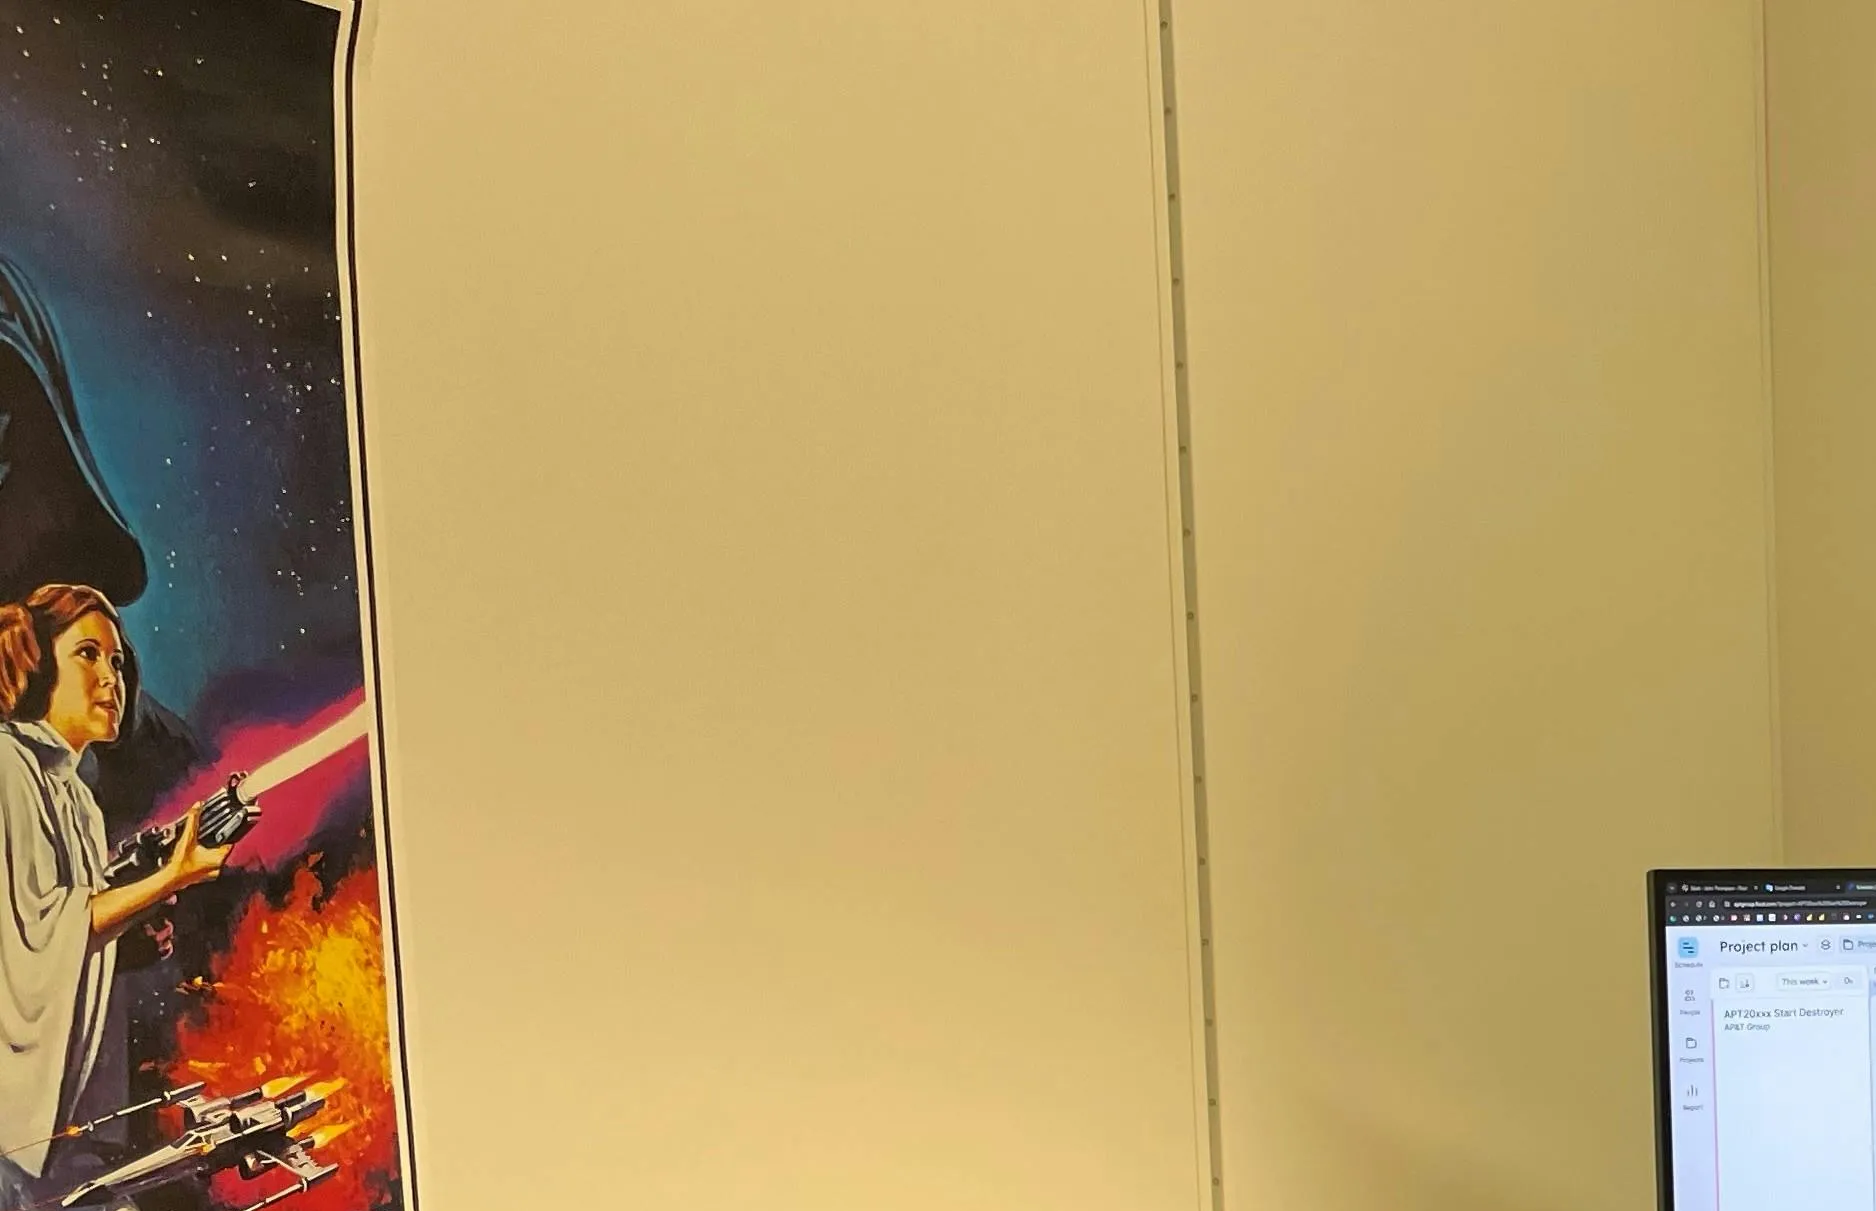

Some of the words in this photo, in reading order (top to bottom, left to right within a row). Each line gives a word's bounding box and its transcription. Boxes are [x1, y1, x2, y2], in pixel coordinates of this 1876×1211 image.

[1720, 940, 1765, 954] Project
[1770, 940, 1798, 954] plan
[1782, 977, 1798, 986] This
[1799, 977, 1819, 986] week
[1724, 1009, 1771, 1019] APT20xxx
[1774, 1008, 1797, 1017] Start
[1799, 1008, 1844, 1018] Destroyer
[1747, 1023, 1770, 1032] Group
